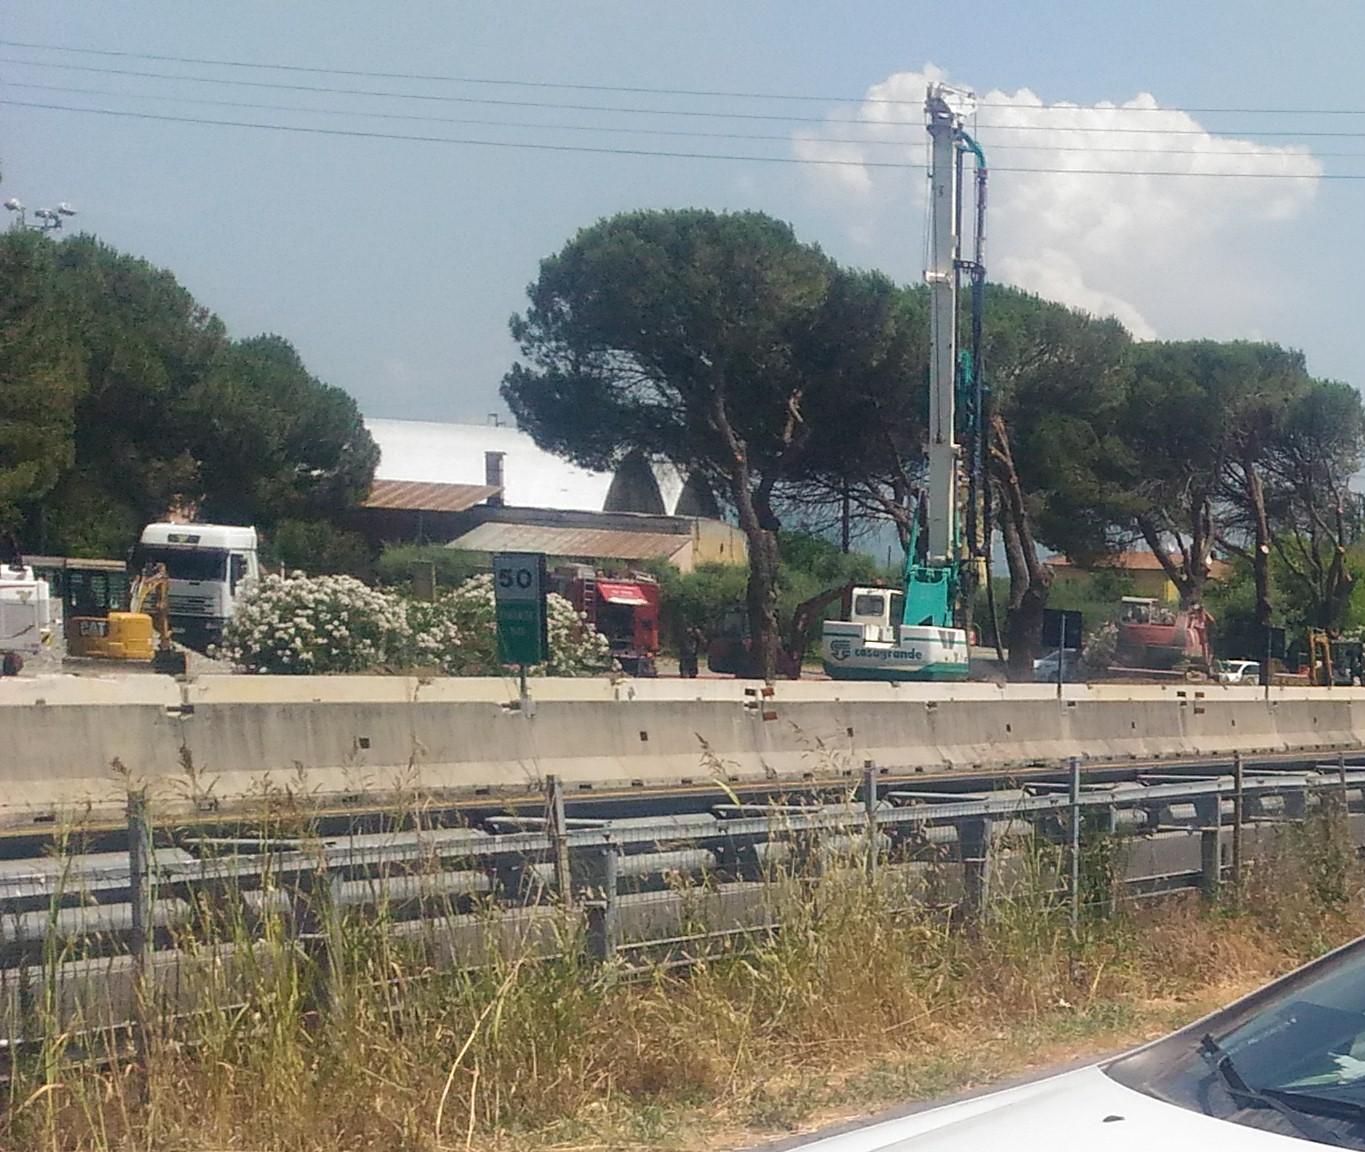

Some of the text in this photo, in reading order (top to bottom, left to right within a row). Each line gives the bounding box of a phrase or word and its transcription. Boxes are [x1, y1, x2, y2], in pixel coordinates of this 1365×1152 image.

[499, 568, 533, 589] 50
[79, 620, 106, 637] CAT
[854, 647, 923, 661] casagrande
